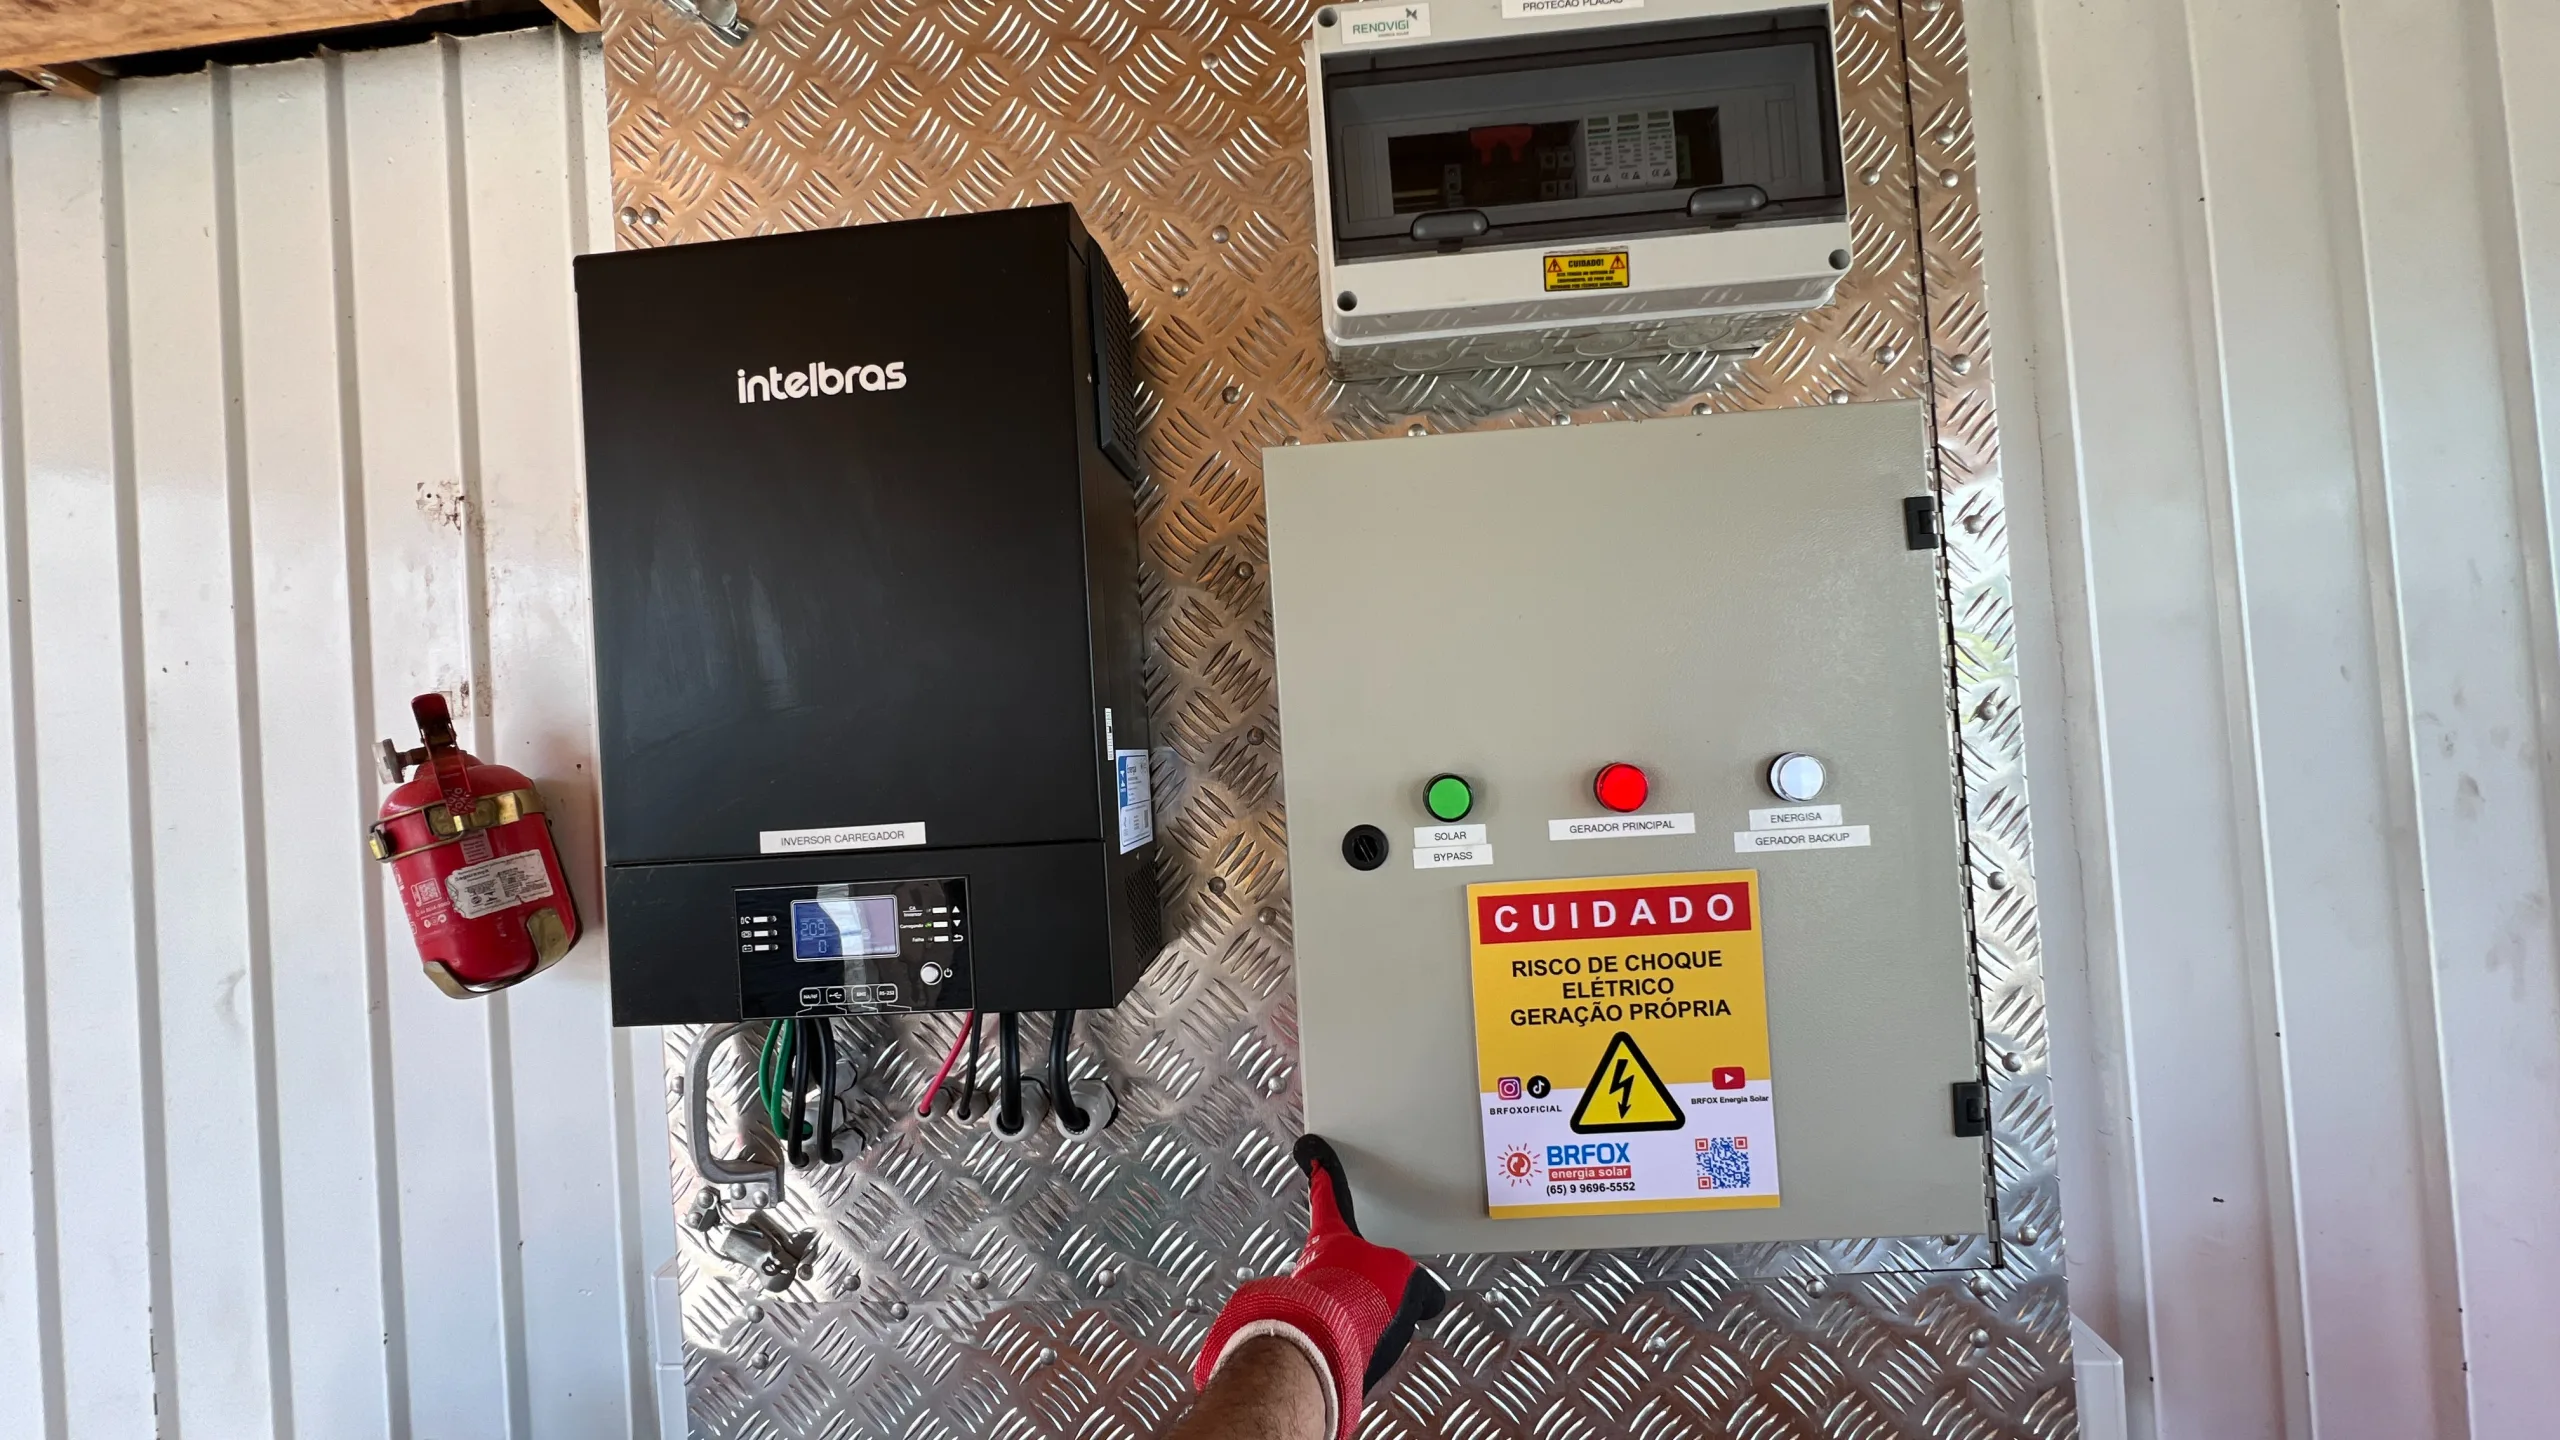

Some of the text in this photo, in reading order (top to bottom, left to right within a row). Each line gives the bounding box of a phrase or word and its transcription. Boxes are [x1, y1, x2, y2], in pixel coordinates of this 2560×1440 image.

[1352, 20, 1410, 35] RENOVIGI
[1567, 258, 1605, 268] CUIDADO!
[737, 361, 907, 404] intelbras
[1770, 812, 1822, 824] ENERGISA
[1569, 820, 1675, 834] GERADOR PRINCIPAL
[781, 830, 905, 846] INVERSOR CARREGADOR
[1434, 831, 1467, 841] SOLAR
[1755, 832, 1850, 846] GERADOR BACKUP
[1433, 851, 1473, 862] BYPASS
[1494, 893, 1735, 933] CUIDADO
[1512, 950, 1723, 978] RISCO DE CHOQUE
[1562, 977, 1675, 999] ELÉTRICO
[1510, 997, 1732, 1027] GERAÇÃO PRÓPRIA
[1691, 1097, 1718, 1105] BRFOX
[1720, 1096, 1748, 1104] Energia
[1489, 1105, 1562, 1115] BRFOXOFICIAL
[1546, 1142, 1631, 1166] BRFOX
[1551, 1167, 1629, 1180] energia solar
[1546, 1182, 1636, 1197] (65) 9 9696-5552
